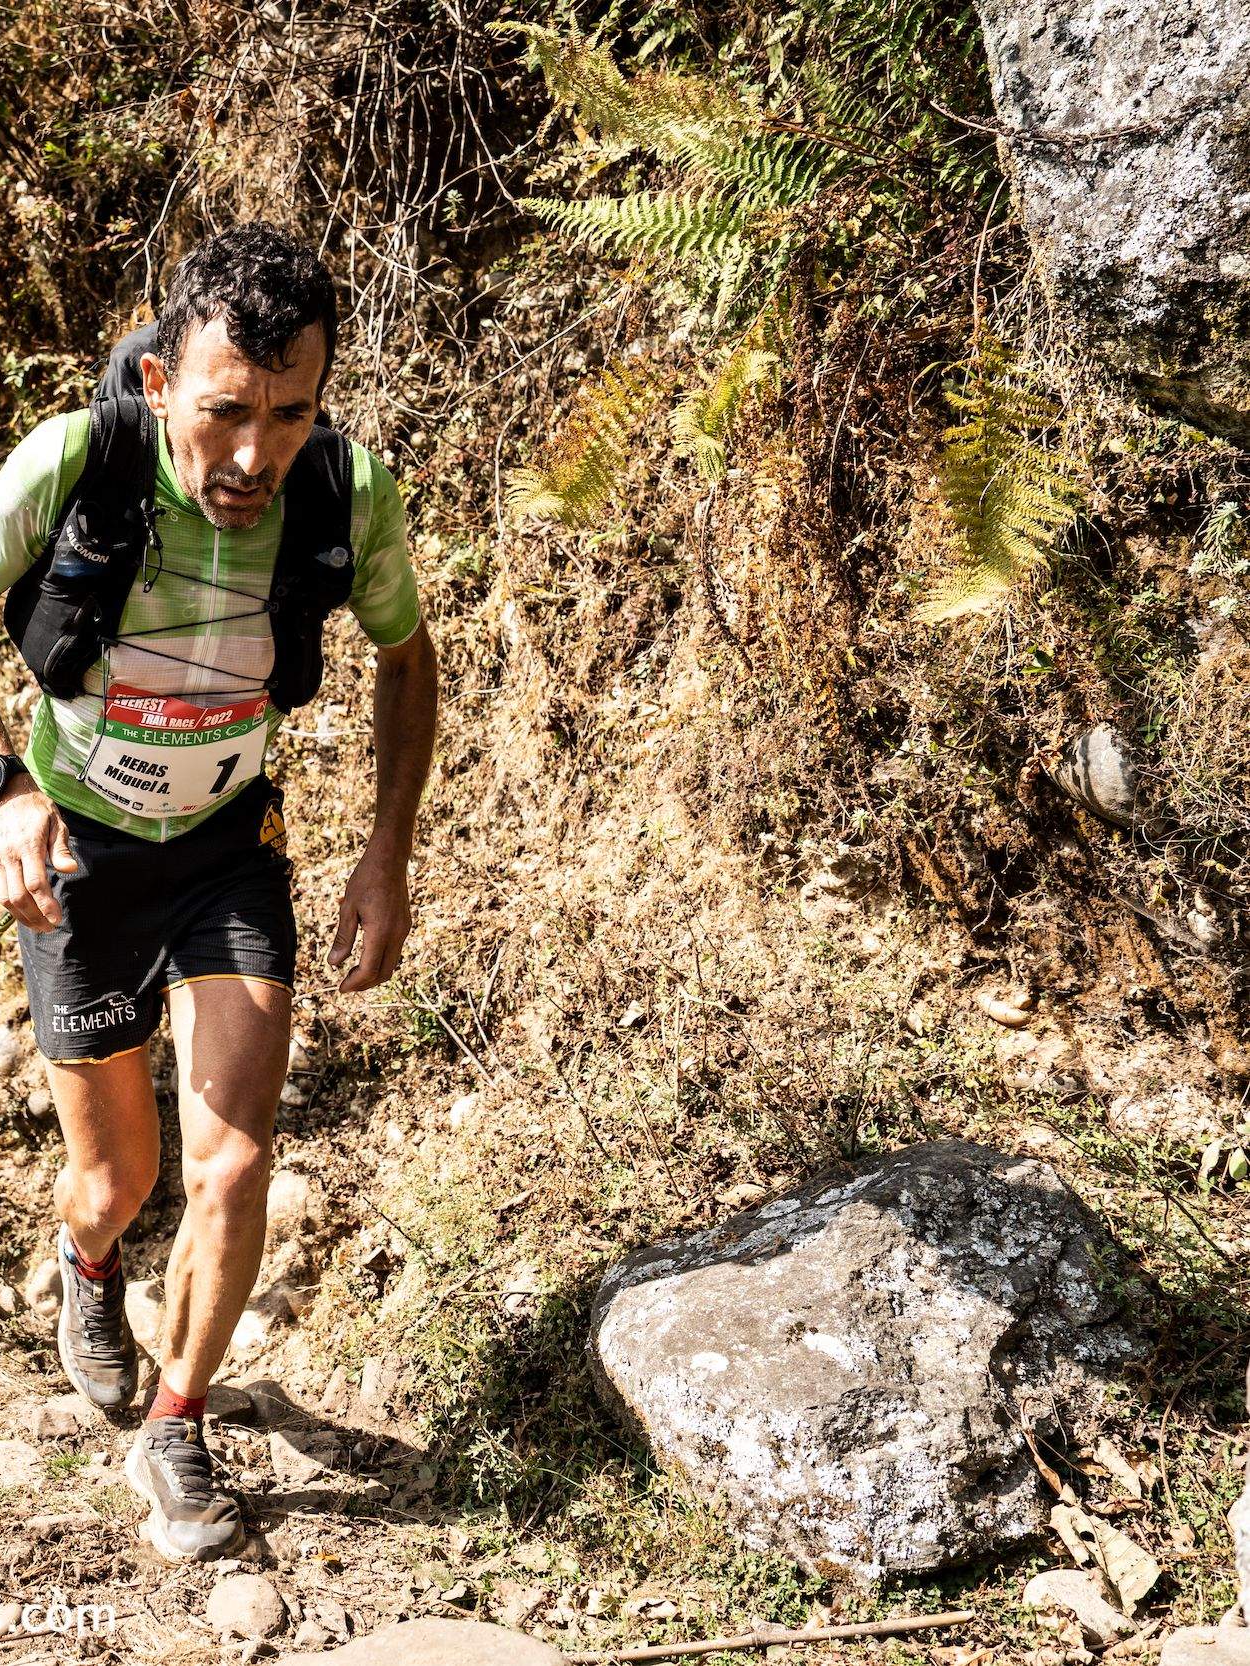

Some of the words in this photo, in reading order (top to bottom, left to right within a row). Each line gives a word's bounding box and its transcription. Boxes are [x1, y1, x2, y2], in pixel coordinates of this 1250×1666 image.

[66, 524, 110, 564] SALOMON
[113, 693, 167, 712] EVEREST
[141, 712, 168, 727] TRAIL
[169, 717, 196, 728] RACE
[202, 709, 233, 727] 2022
[122, 728, 139, 738] THE
[142, 728, 222, 745] ELEMENTS
[103, 764, 159, 792] Miguel
[118, 754, 169, 778] HERAS
[209, 752, 242, 794] 1
[52, 1004, 70, 1014] THE
[52, 1004, 136, 1033] ELEMENTS
